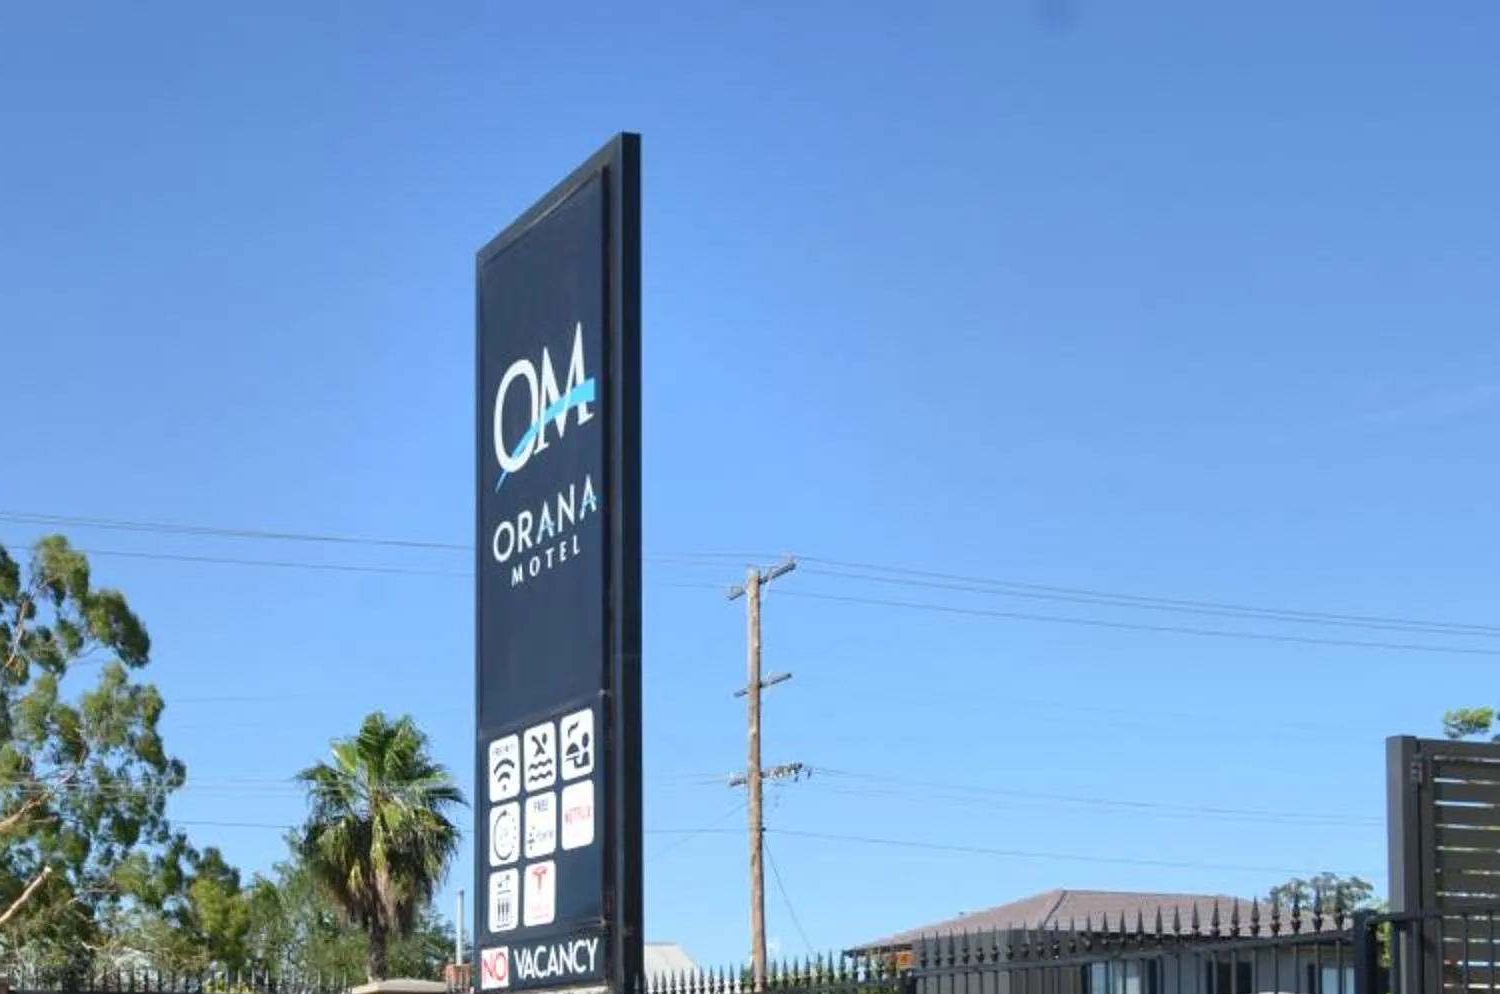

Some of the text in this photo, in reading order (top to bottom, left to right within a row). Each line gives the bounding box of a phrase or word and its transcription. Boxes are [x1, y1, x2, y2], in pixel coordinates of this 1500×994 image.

[493, 321, 595, 473] OM
[493, 474, 597, 562] ORANA
[511, 535, 581, 586] MOTEL
[482, 937, 598, 982] NO VACANCY
